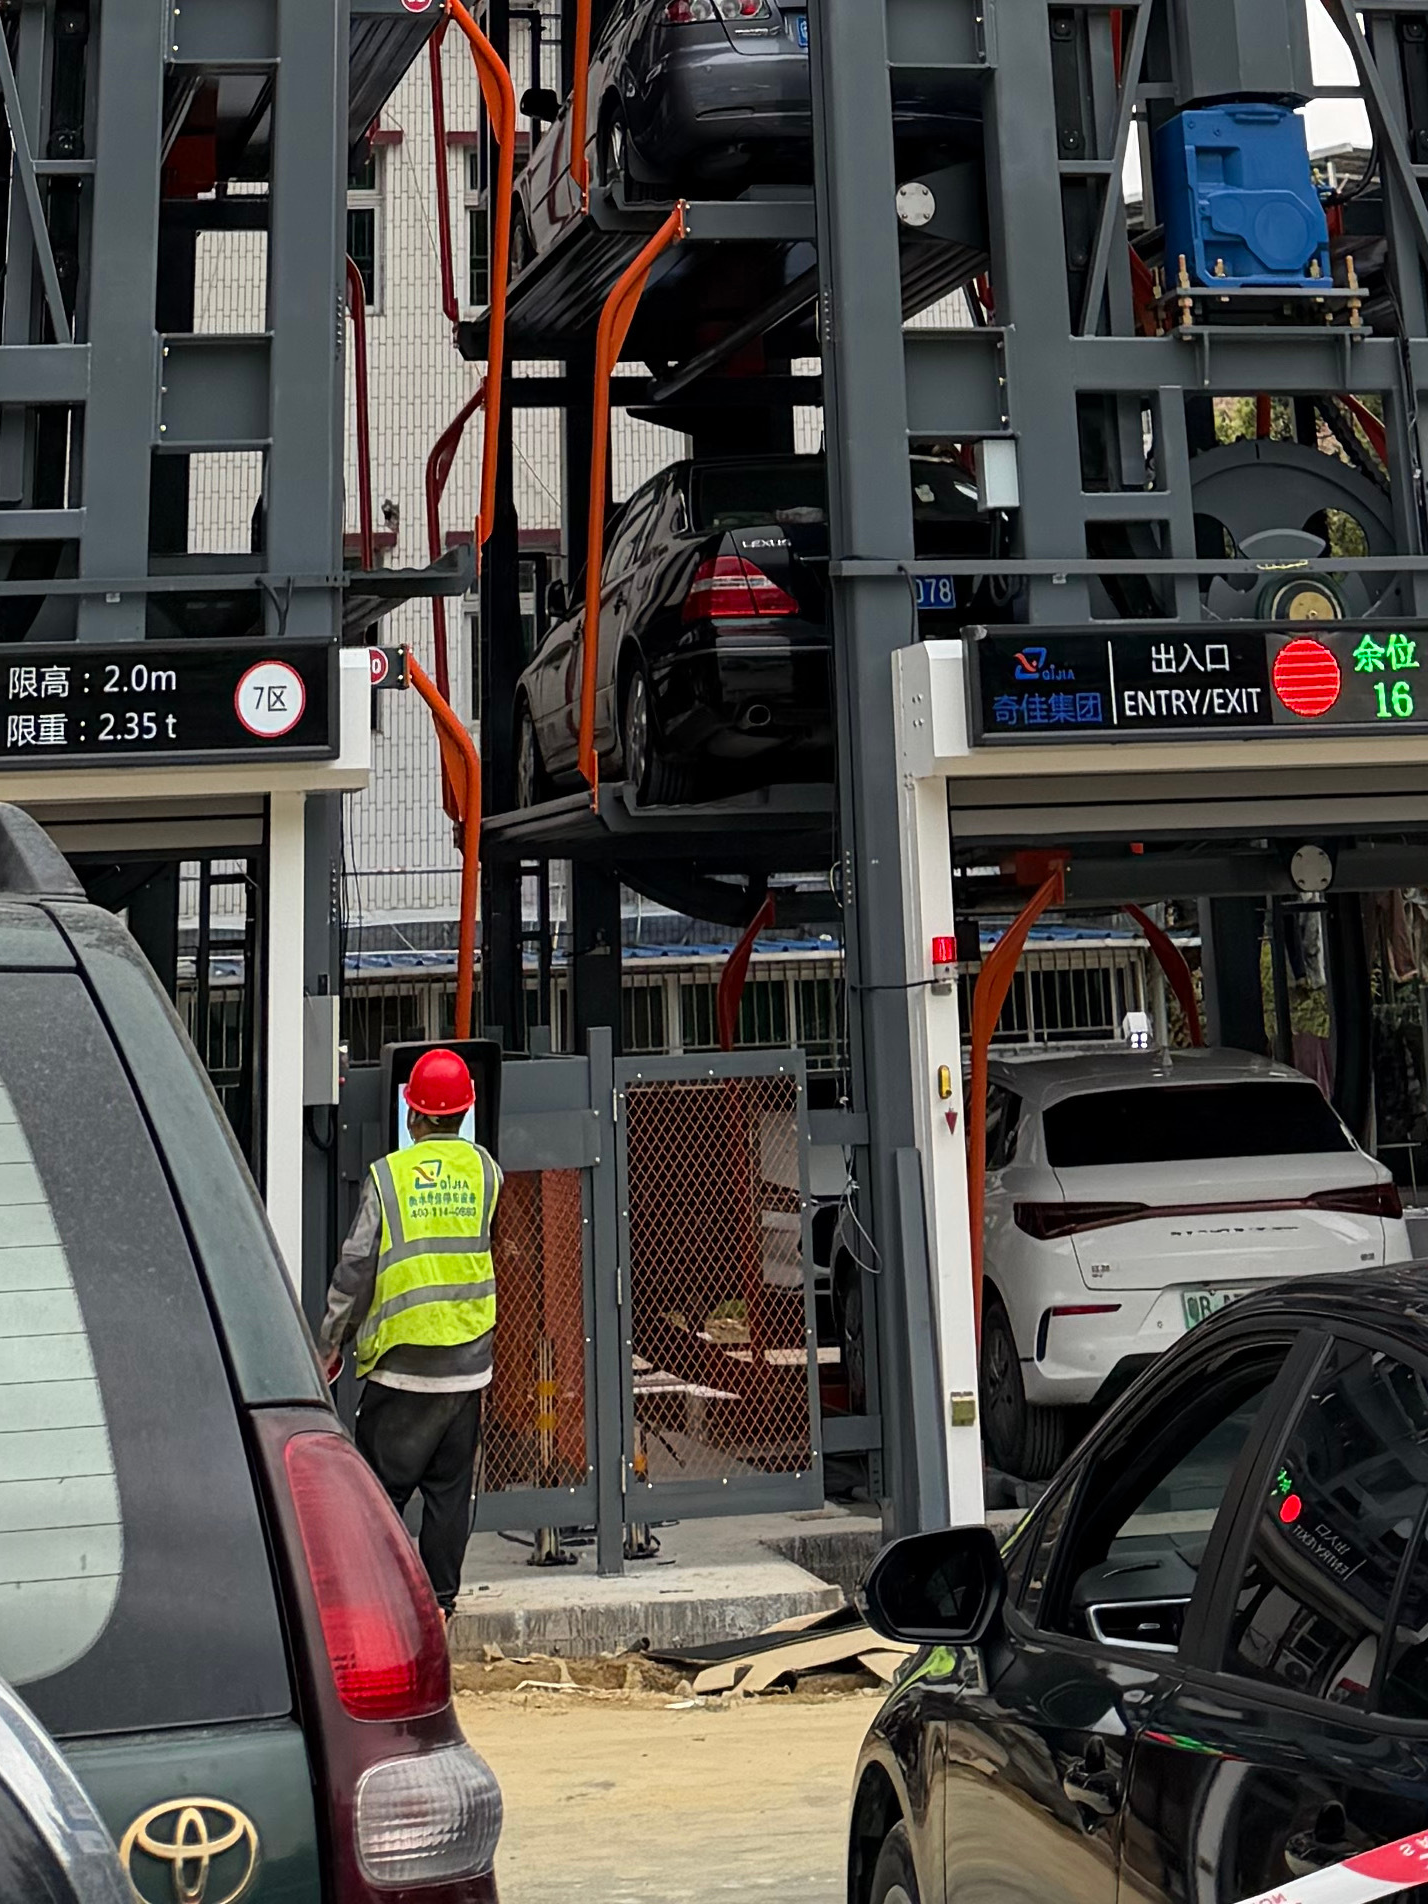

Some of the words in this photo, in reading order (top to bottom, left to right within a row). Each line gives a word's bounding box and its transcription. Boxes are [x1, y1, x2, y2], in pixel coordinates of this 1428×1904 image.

[1152, 643, 1230, 673] 出入口
[1353, 633, 1420, 672] 余位
[253, 685, 288, 712] 7区
[993, 692, 1103, 725] 奇佳集团
[1124, 688, 1261, 717] ENTRY/EXIT
[1374, 680, 1414, 718] 16
